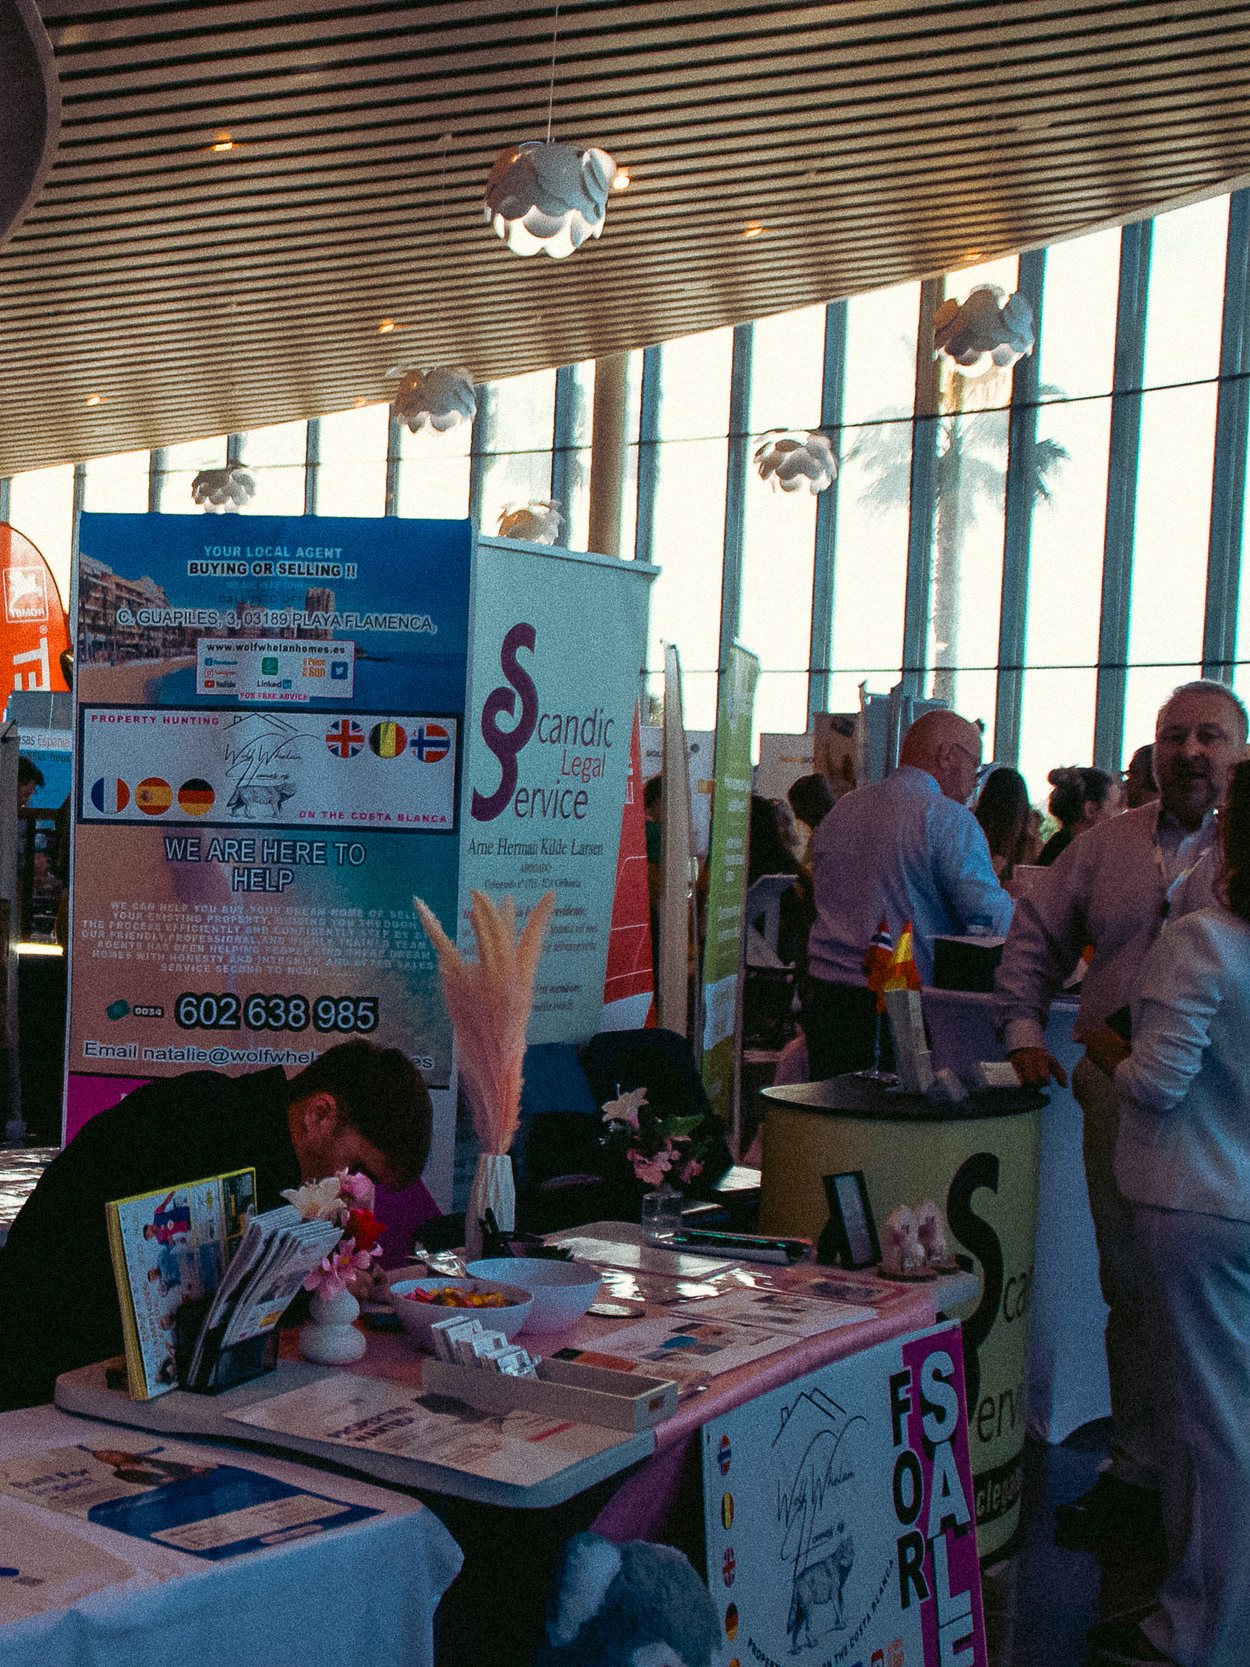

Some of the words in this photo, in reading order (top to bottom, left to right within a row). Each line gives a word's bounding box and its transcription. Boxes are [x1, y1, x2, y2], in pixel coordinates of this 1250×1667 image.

[204, 545, 241, 557] YOUR
[246, 546, 291, 558] LOCAL
[296, 547, 343, 559] AGENT
[188, 562, 247, 575] BUYING
[253, 563, 273, 576] OR
[278, 564, 342, 577] SELLING
[138, 609, 223, 627] GUAPILES,
[226, 611, 241, 628] 3,
[244, 611, 288, 626] 03189
[293, 613, 341, 628] PLAYA
[345, 614, 438, 633] FLAMENCA,
[206, 643, 346, 654] www.wolfwhelanhomes.es
[91, 714, 156, 724] PROPERTY
[162, 716, 220, 726] HUNTING
[561, 750, 606, 783] Legal
[299, 810, 317, 819] ON
[321, 811, 345, 820] THE
[351, 812, 392, 822] COSTA
[397, 813, 447, 823] BLANCA
[164, 837, 200, 861] WE
[207, 838, 254, 863] ARE
[261, 839, 328, 865] HERE
[334, 842, 366, 866] TO
[468, 838, 493, 855] Arne
[497, 838, 538, 855] Herman
[541, 838, 567, 855] Kilde
[571, 839, 604, 856] Larsen
[232, 868, 294, 892] HELP
[110, 901, 127, 910] WE
[133, 902, 156, 911] CAN
[160, 903, 189, 912] HELP
[194, 904, 217, 913] YOU
[112, 911, 143, 920] YOUR
[81, 919, 105, 929] THE
[109, 921, 162, 932] PROCESS
[165, 923, 240, 933] EFFICIENTLY
[81, 930, 106, 939] OUR
[173, 943, 205, 952] BEEN
[92, 950, 132, 960] HOMES
[136, 951, 165, 961] WITH
[169, 953, 224, 963] HONESTY
[160, 963, 211, 973] SERVICE
[215, 964, 262, 974] SECOND
[267, 965, 282, 975] TO
[177, 996, 238, 1027] 602
[247, 997, 307, 1028] 638
[316, 998, 377, 1030] 985
[84, 1041, 137, 1060] Email
[889, 1366, 931, 1611] FOR
